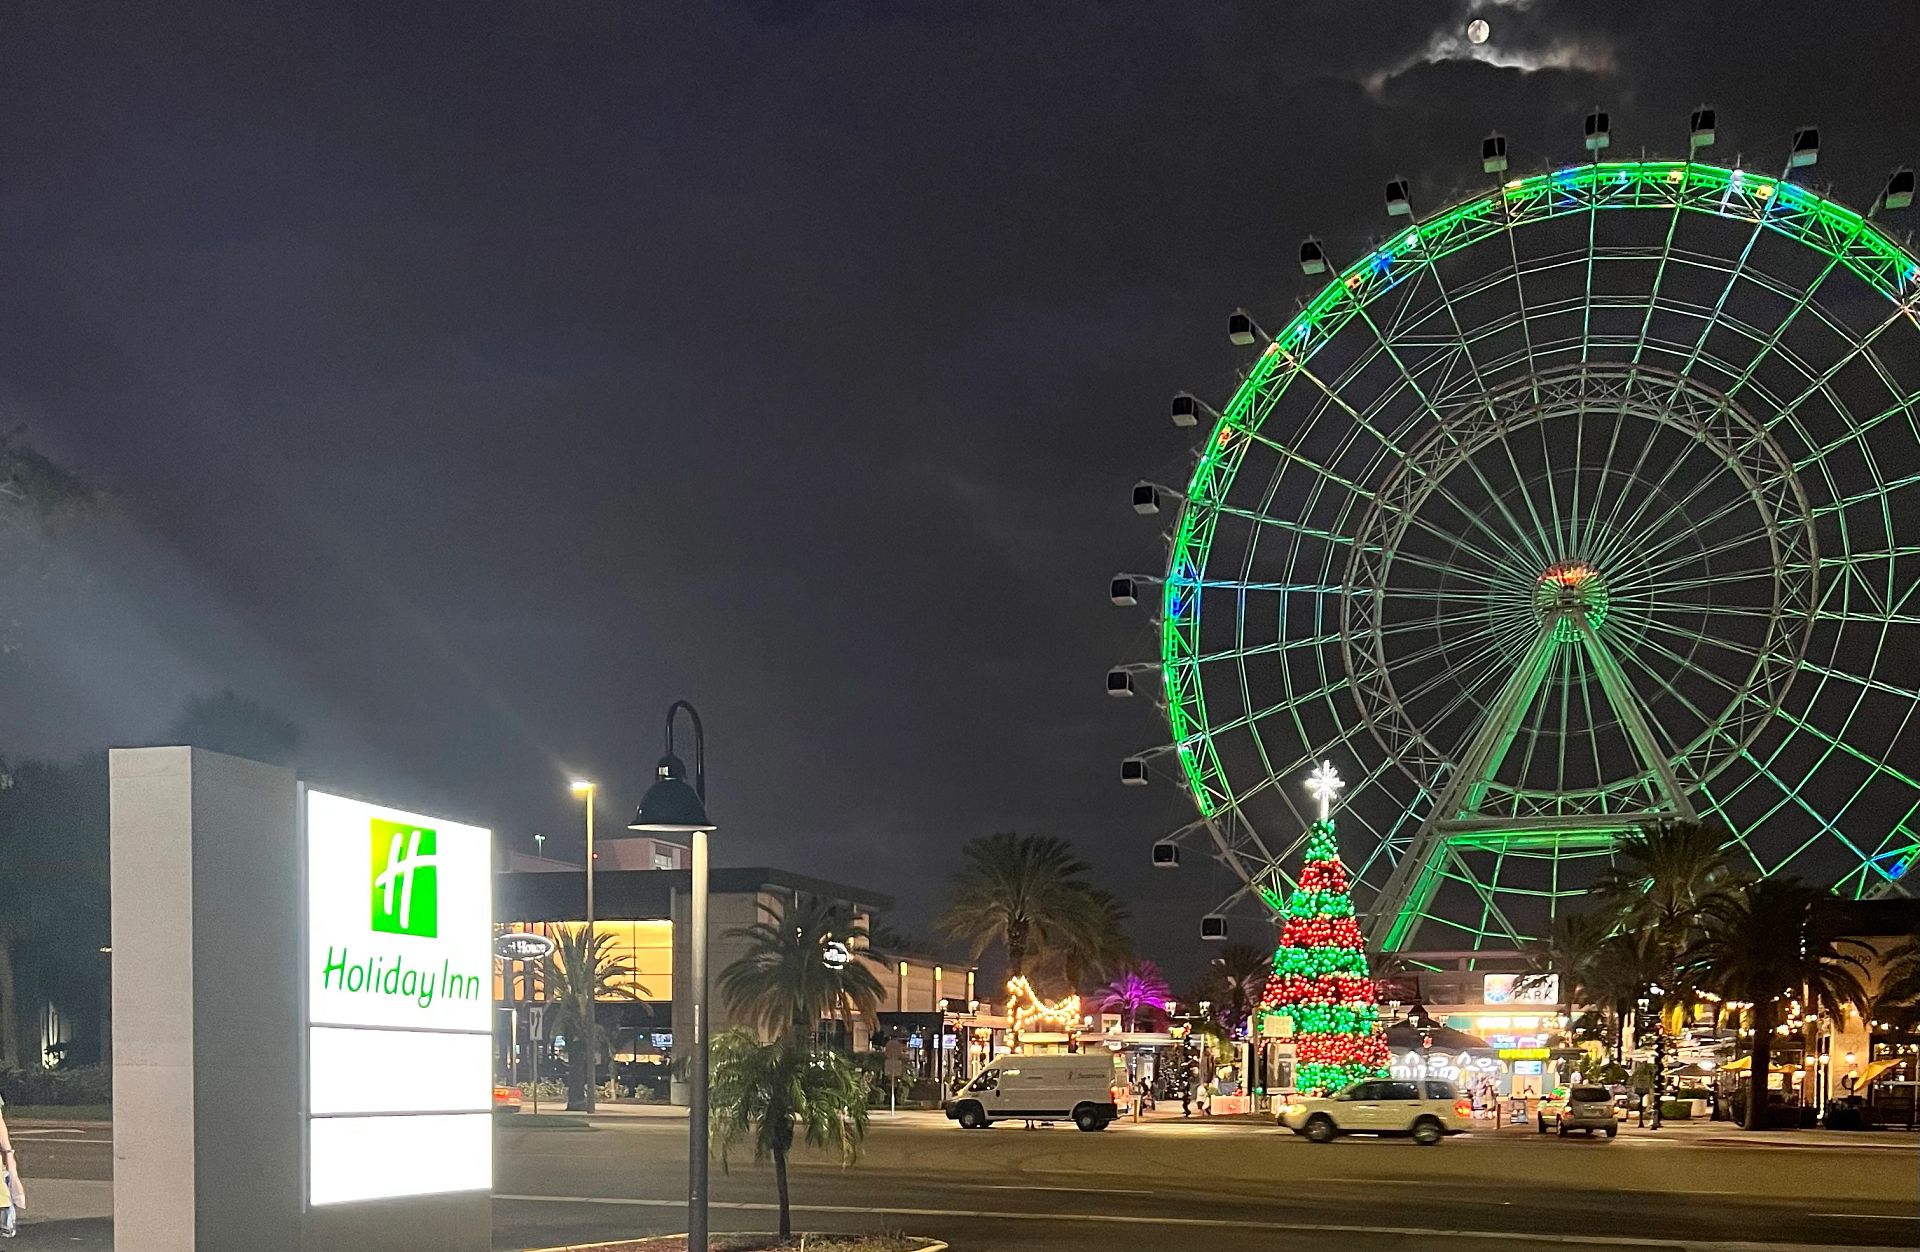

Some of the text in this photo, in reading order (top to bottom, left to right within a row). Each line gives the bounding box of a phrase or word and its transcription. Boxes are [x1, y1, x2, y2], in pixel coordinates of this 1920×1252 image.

[323, 946, 480, 1009] Holiday Inn
[1514, 990, 1552, 1000] PARK
